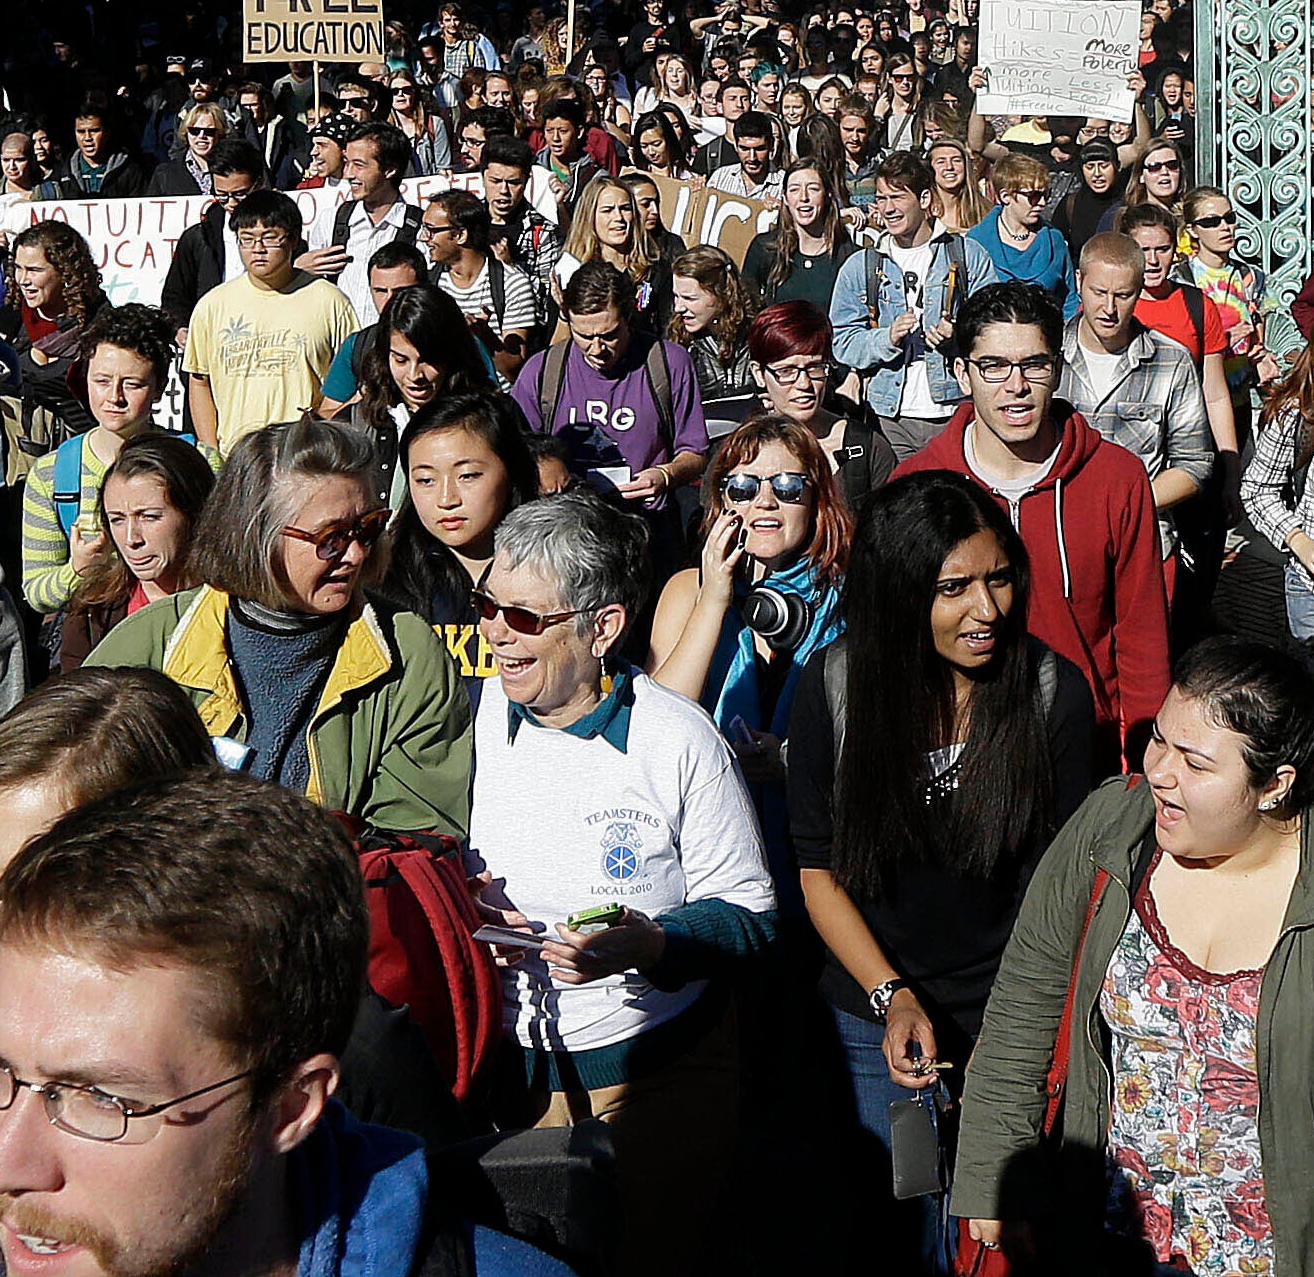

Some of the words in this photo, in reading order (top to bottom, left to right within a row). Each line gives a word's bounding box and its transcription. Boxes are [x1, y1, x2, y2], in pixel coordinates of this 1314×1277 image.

[983, 0, 1125, 39] TUITION
[248, 21, 383, 55] EDUCATION
[585, 808, 662, 828] TEAMSTERS
[591, 884, 627, 896] LOCAL
[629, 882, 652, 895] 2010
